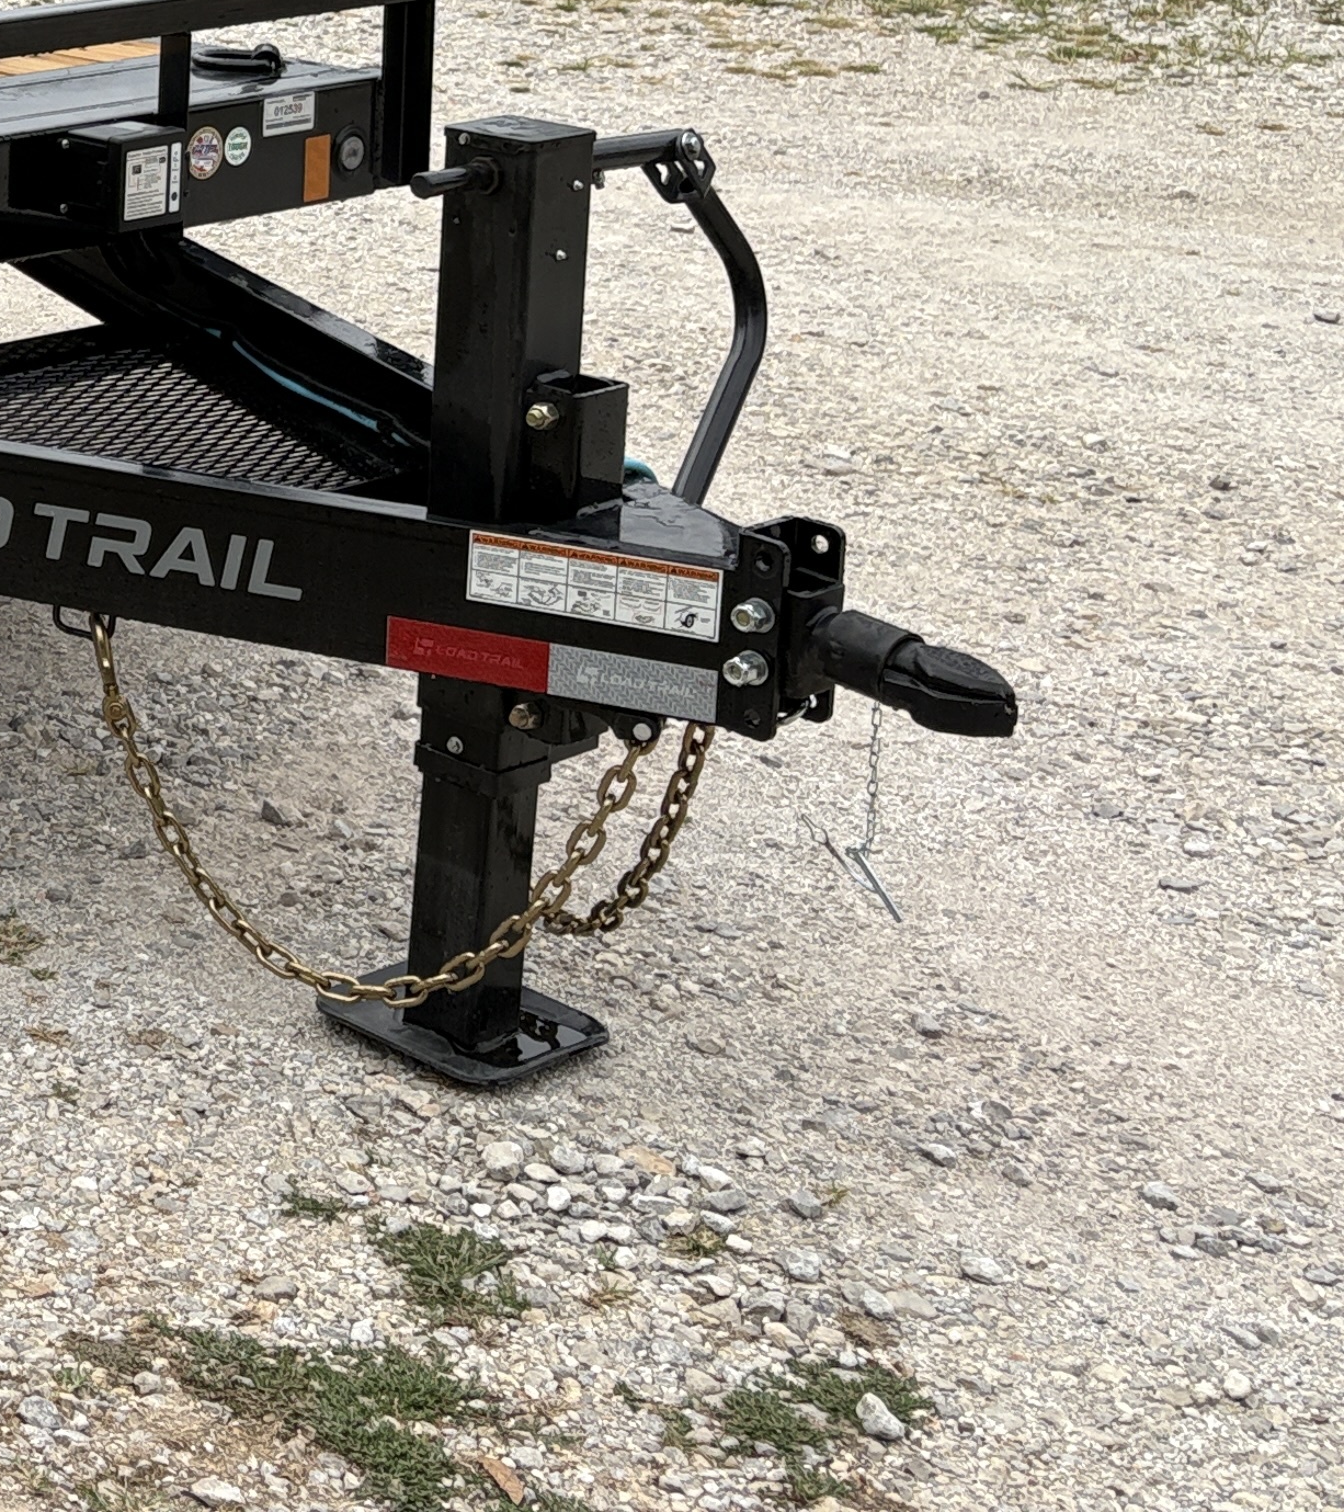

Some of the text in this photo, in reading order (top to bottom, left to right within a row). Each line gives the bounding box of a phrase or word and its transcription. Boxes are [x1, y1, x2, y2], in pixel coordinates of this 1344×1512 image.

[34, 503, 302, 601] TRAIL
[435, 645, 525, 670] LOAD TRAIL
